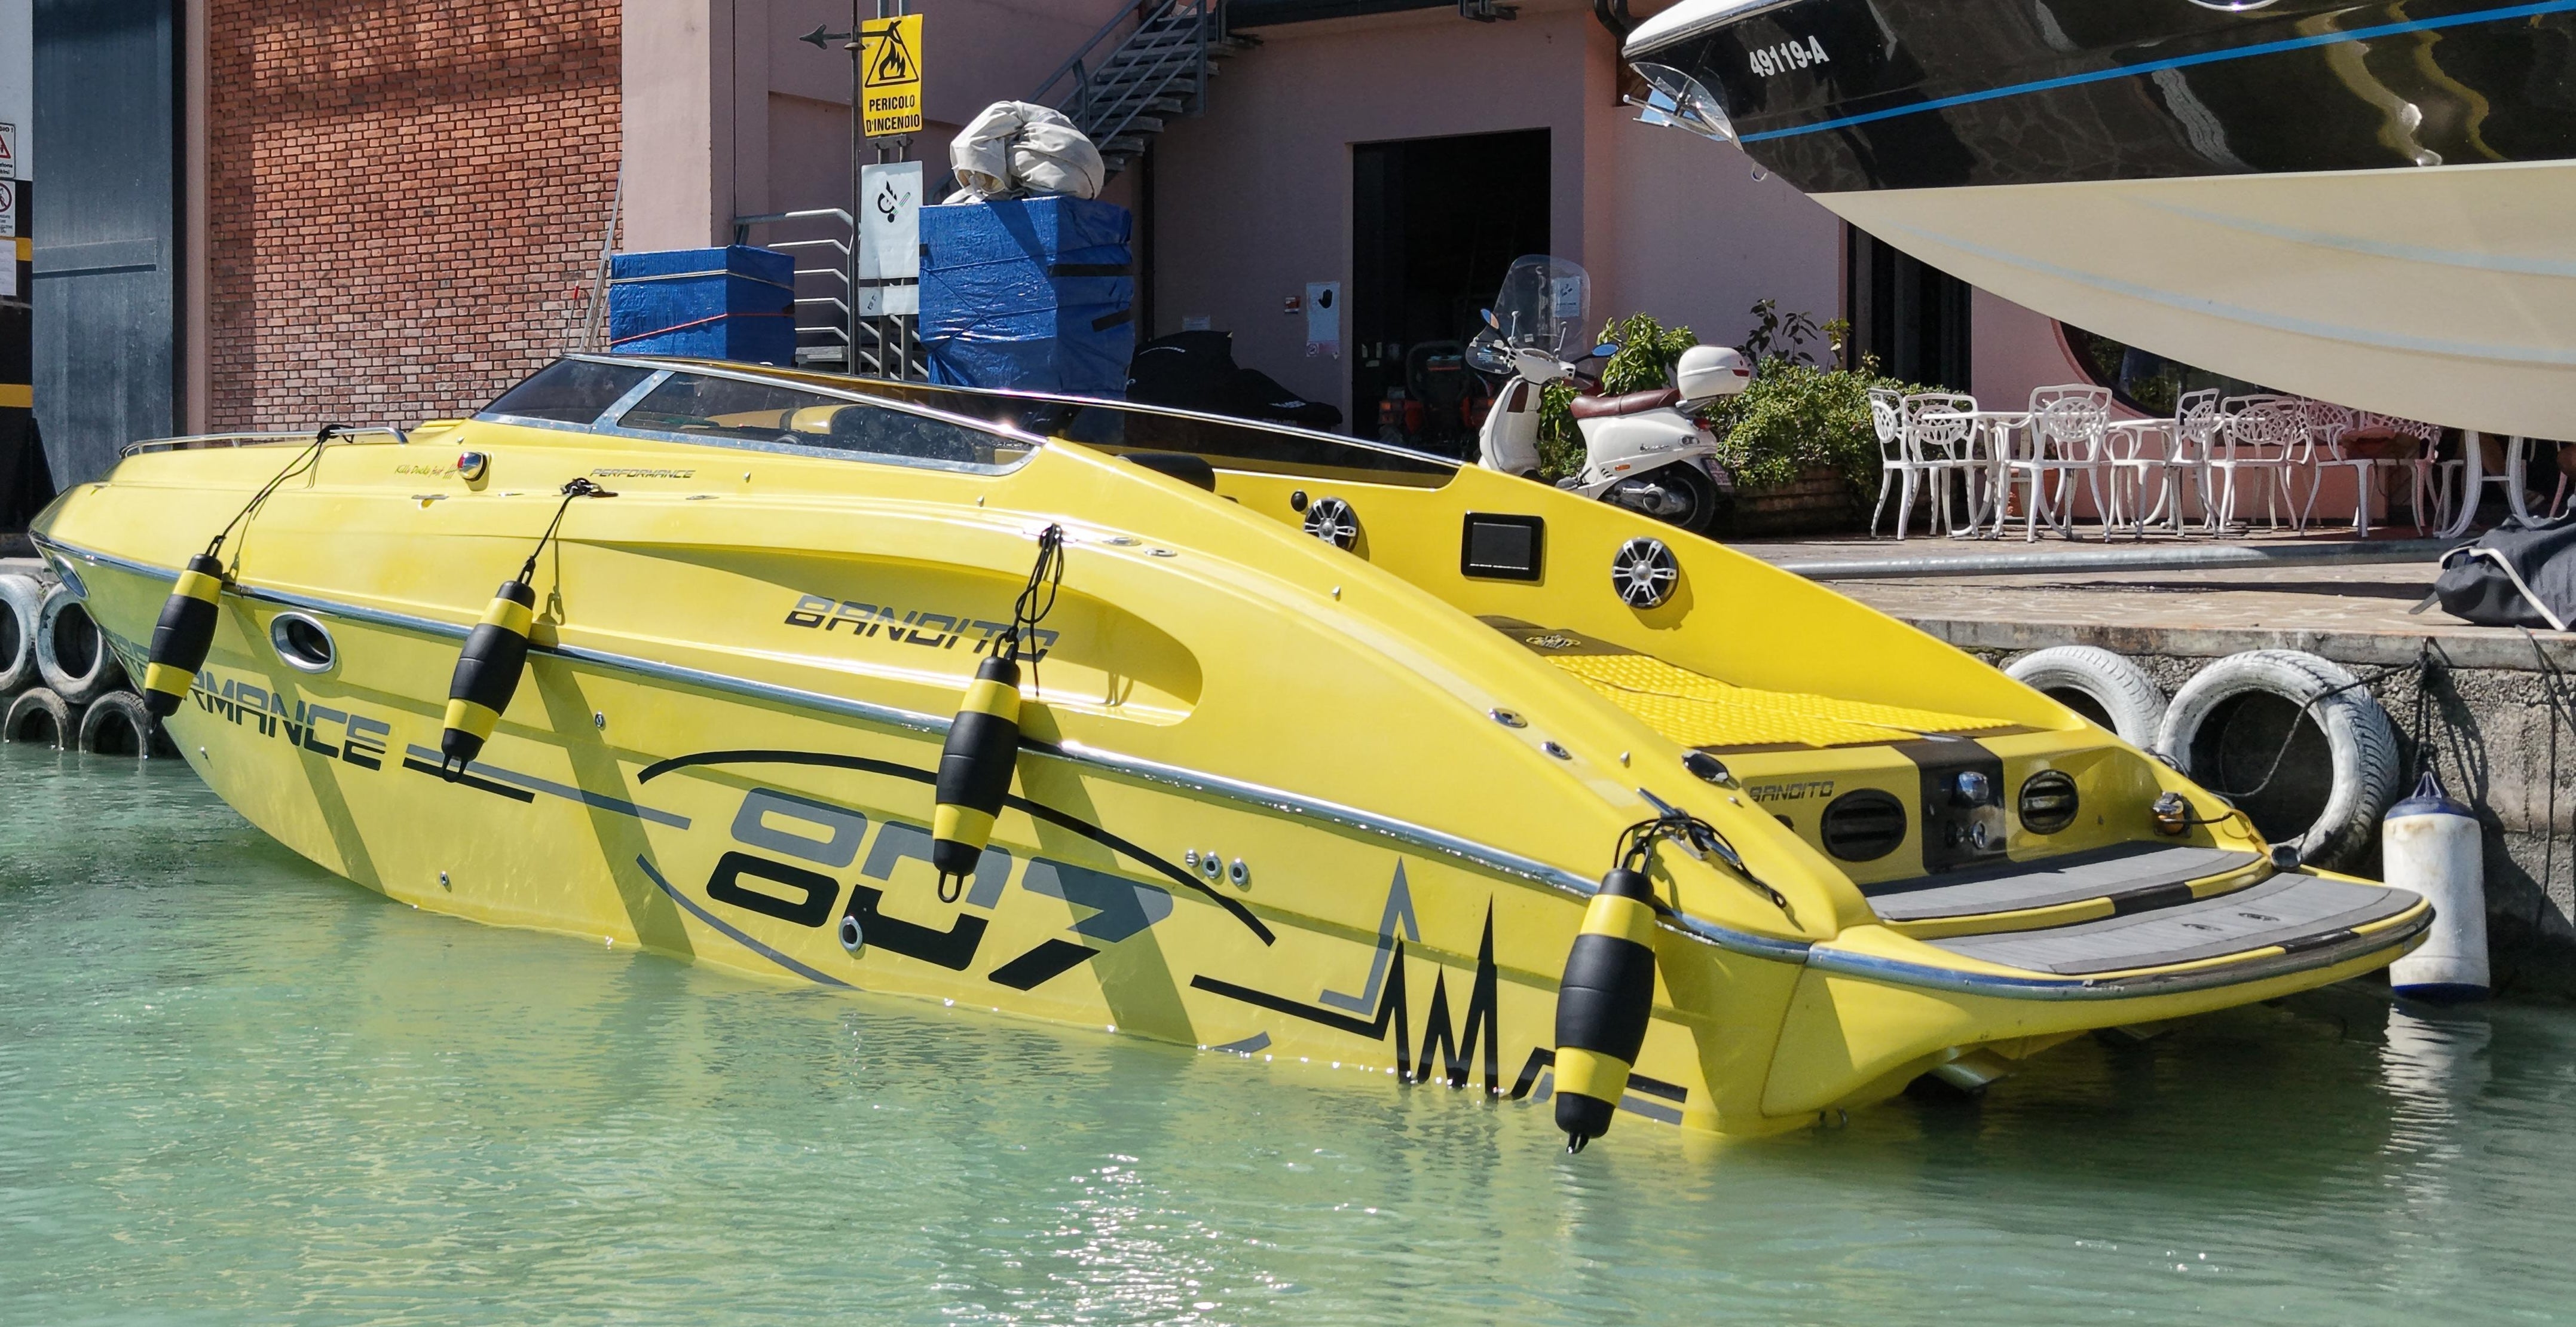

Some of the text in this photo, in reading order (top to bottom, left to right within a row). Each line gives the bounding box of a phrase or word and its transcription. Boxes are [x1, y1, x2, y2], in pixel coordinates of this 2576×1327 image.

[1749, 35, 1830, 77] 49119-A
[869, 94, 915, 112] PERICOLO
[866, 114, 920, 132] D'INCENDIO
[589, 468, 696, 478] PERFORMANCE
[784, 594, 1060, 663] BANDITO
[1749, 781, 1834, 803] BANDITO
[706, 787, 1173, 991] 807
